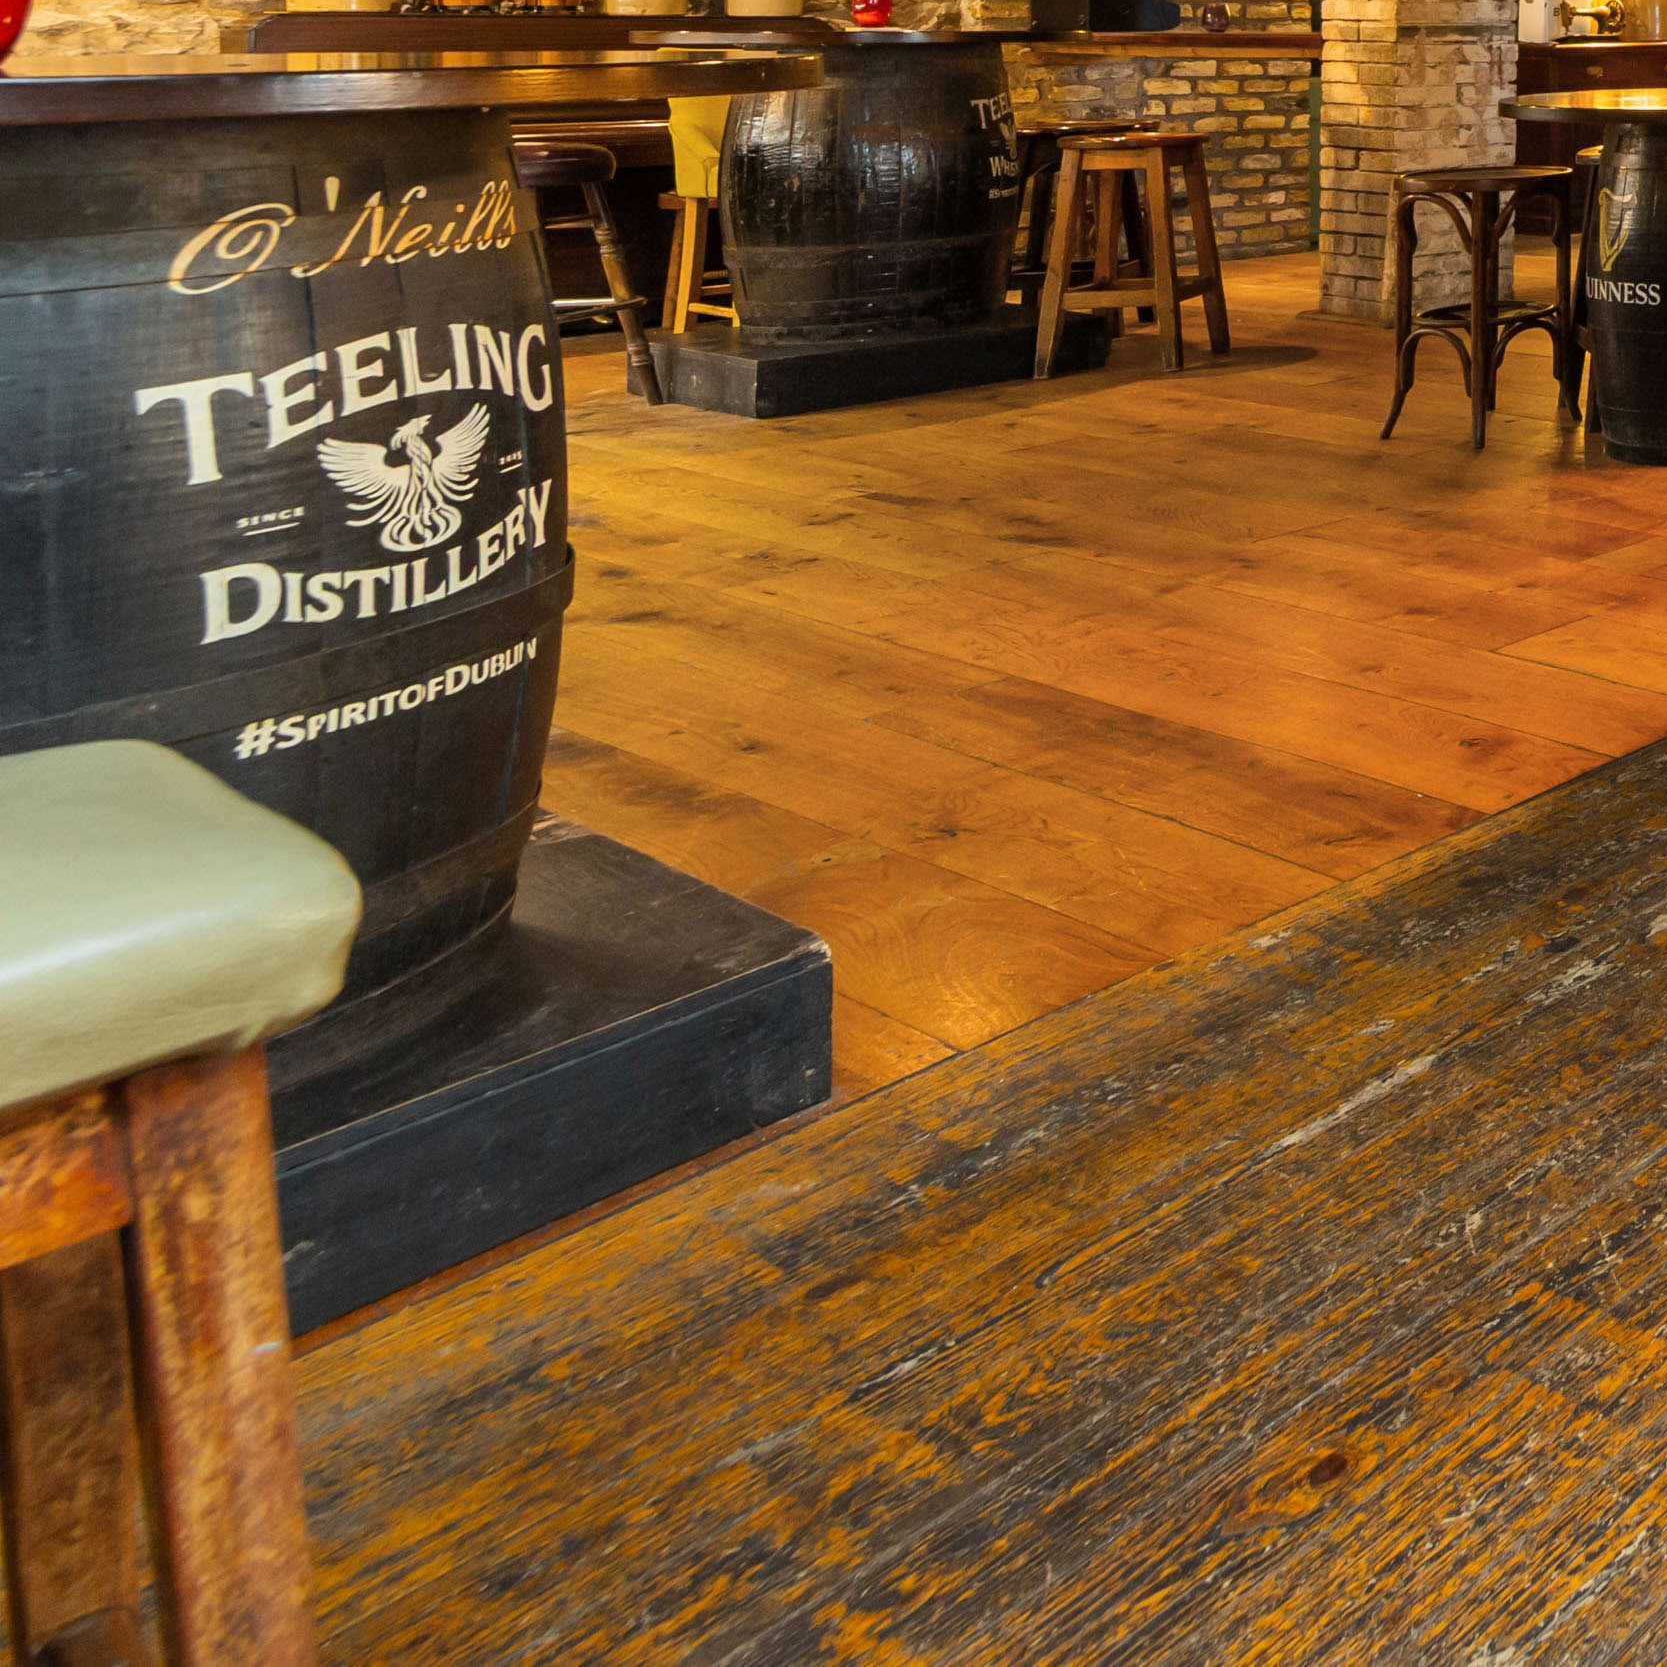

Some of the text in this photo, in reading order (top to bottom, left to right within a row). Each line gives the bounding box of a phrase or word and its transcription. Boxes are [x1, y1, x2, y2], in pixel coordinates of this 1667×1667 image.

[1586, 276, 1662, 306] UINNESS
[135, 323, 553, 486] TEELING
[199, 478, 553, 645] DISTILLERY
[236, 506, 305, 529] SINCE
